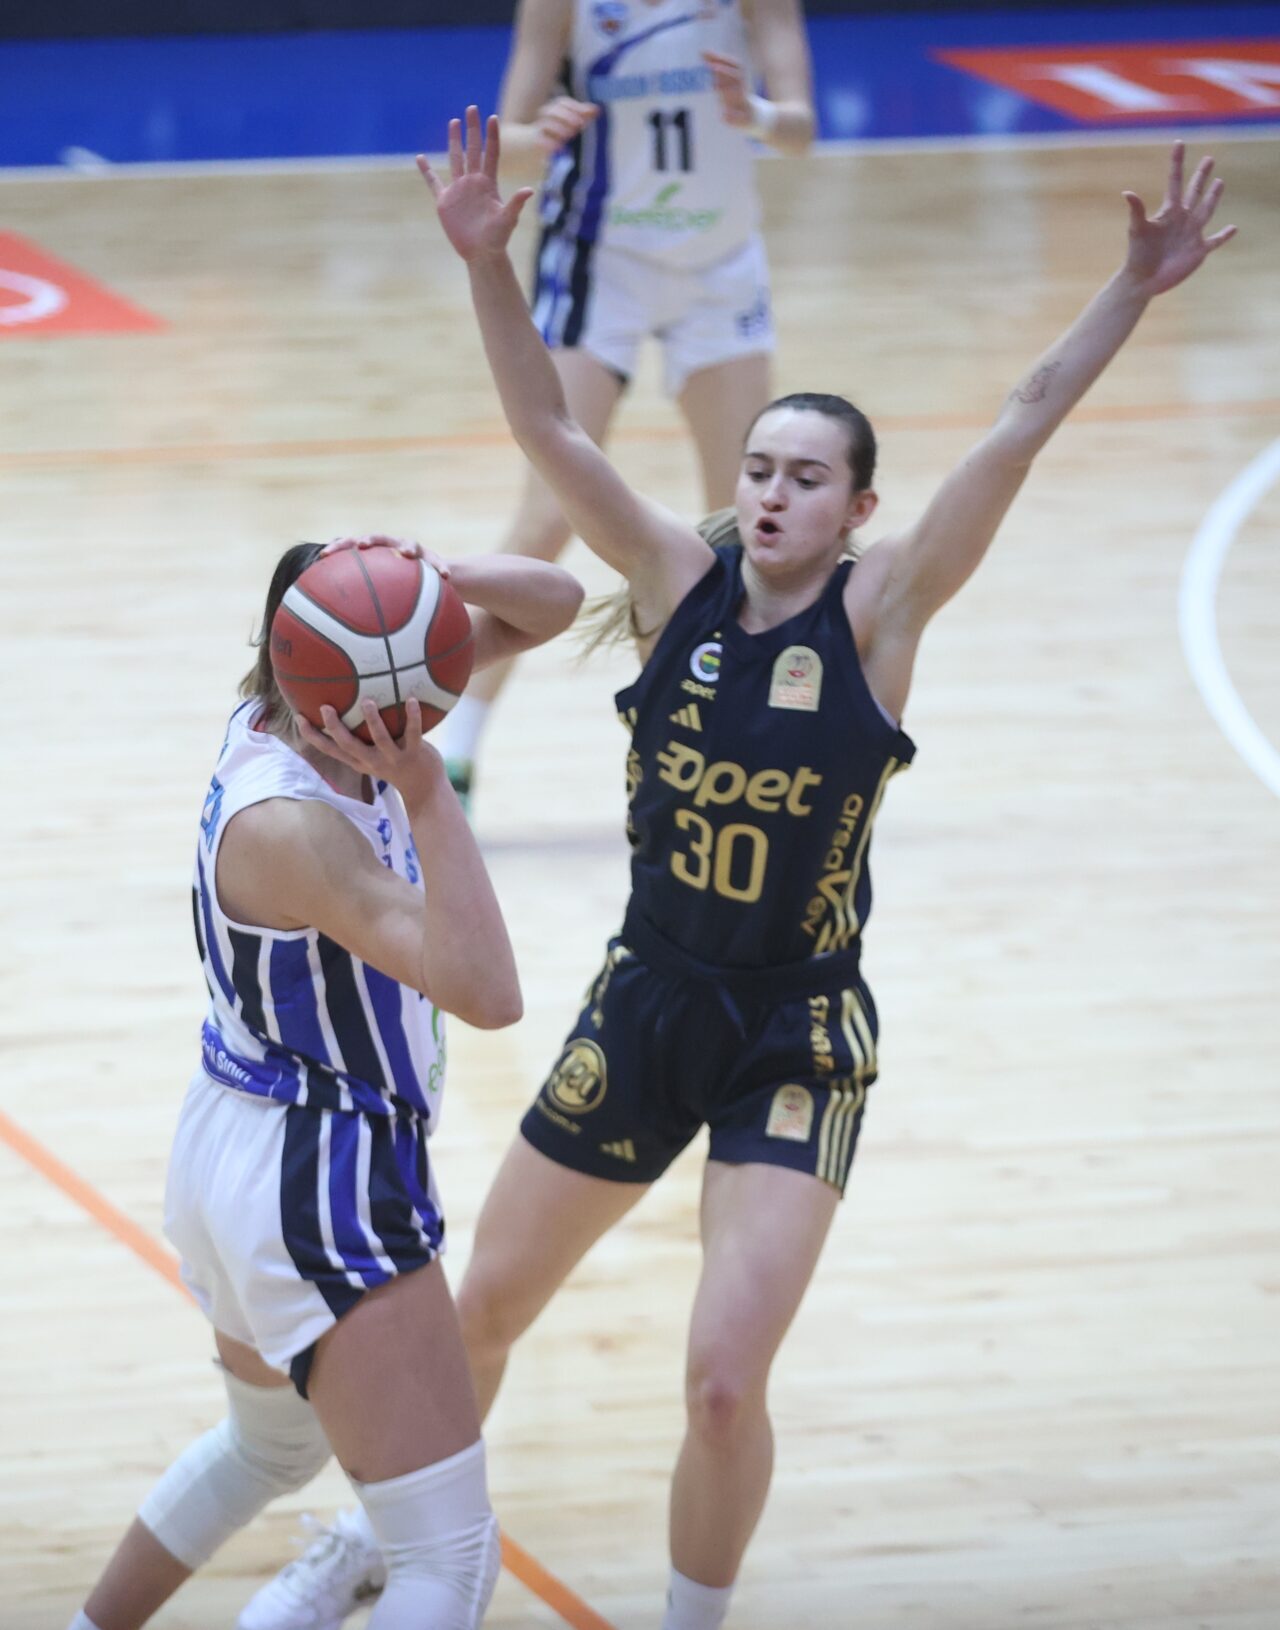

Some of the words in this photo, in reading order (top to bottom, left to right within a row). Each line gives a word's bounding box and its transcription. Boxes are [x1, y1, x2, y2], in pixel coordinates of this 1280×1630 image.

[646, 107, 695, 173] 11
[656, 740, 823, 817] opet
[669, 808, 769, 903] 30
